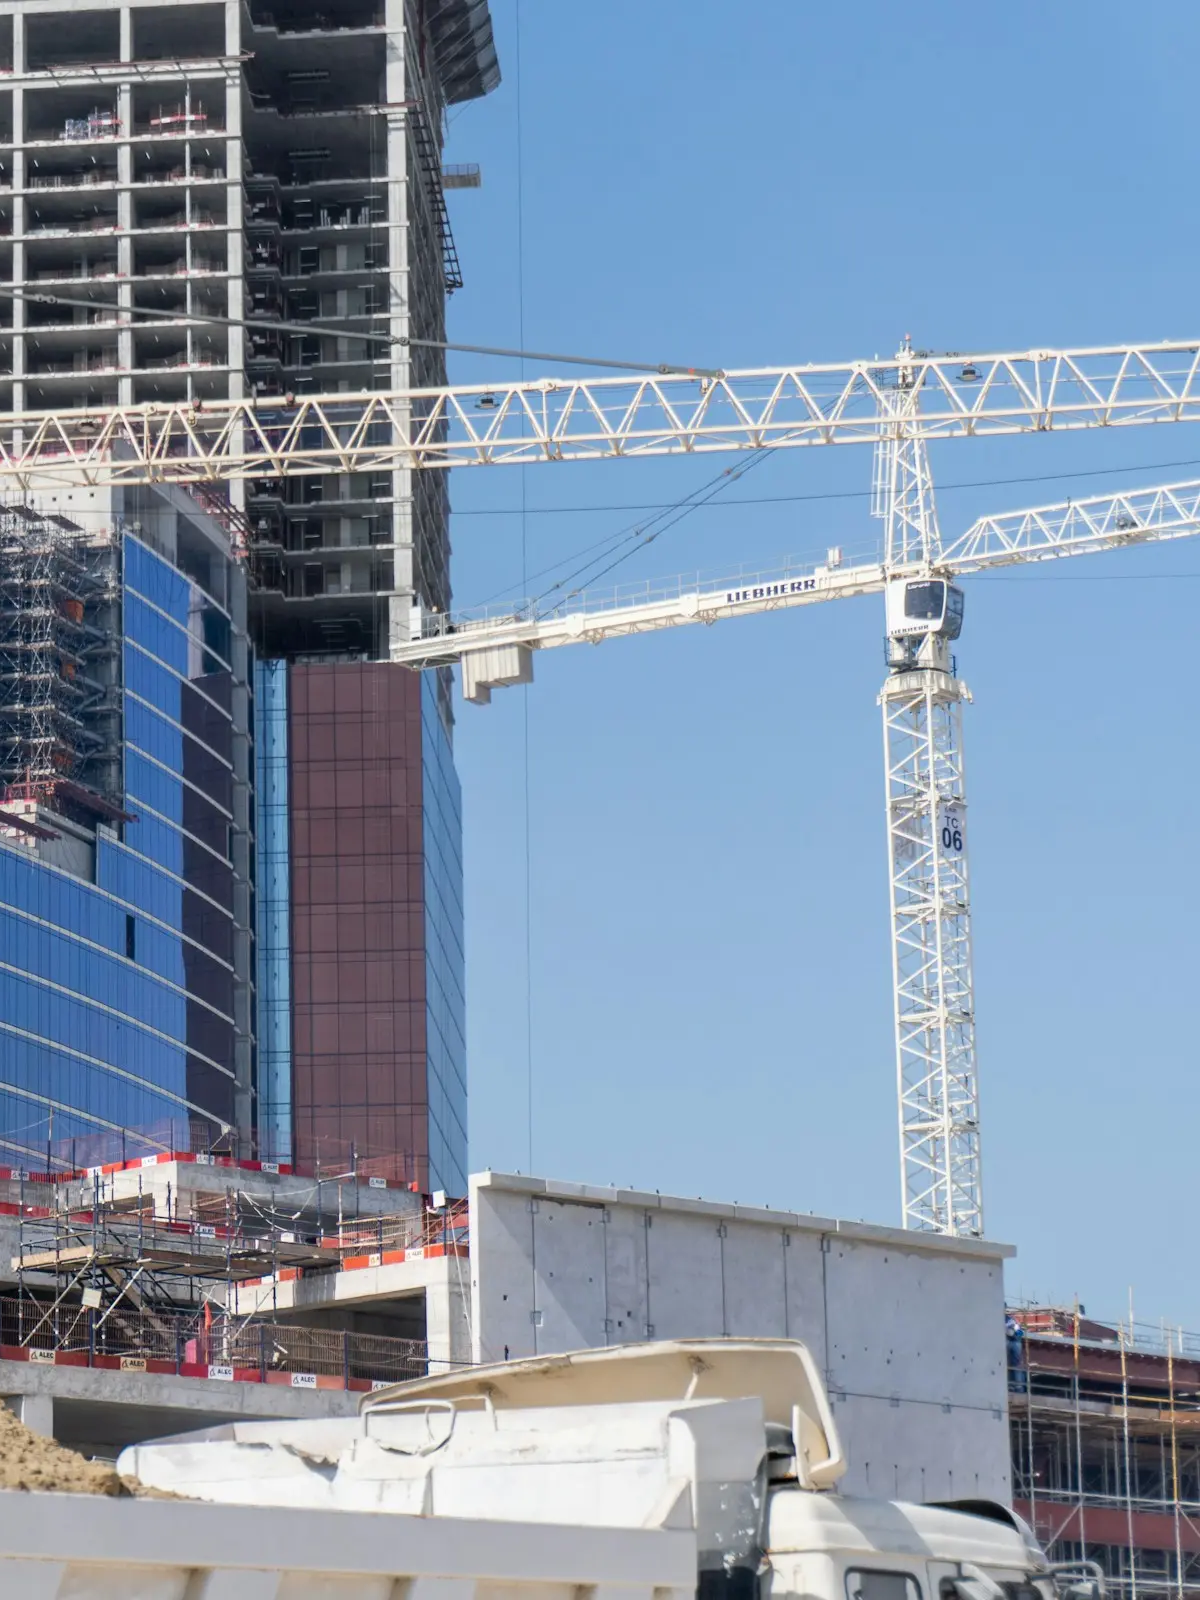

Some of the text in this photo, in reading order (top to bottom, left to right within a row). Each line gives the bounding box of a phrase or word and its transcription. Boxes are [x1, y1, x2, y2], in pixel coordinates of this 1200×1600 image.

[726, 579, 817, 604] LIEBHERR
[944, 816, 960, 829] TC
[942, 827, 963, 852] 06
[39, 1351, 54, 1359] ALEC
[129, 1359, 145, 1368] ALEC
